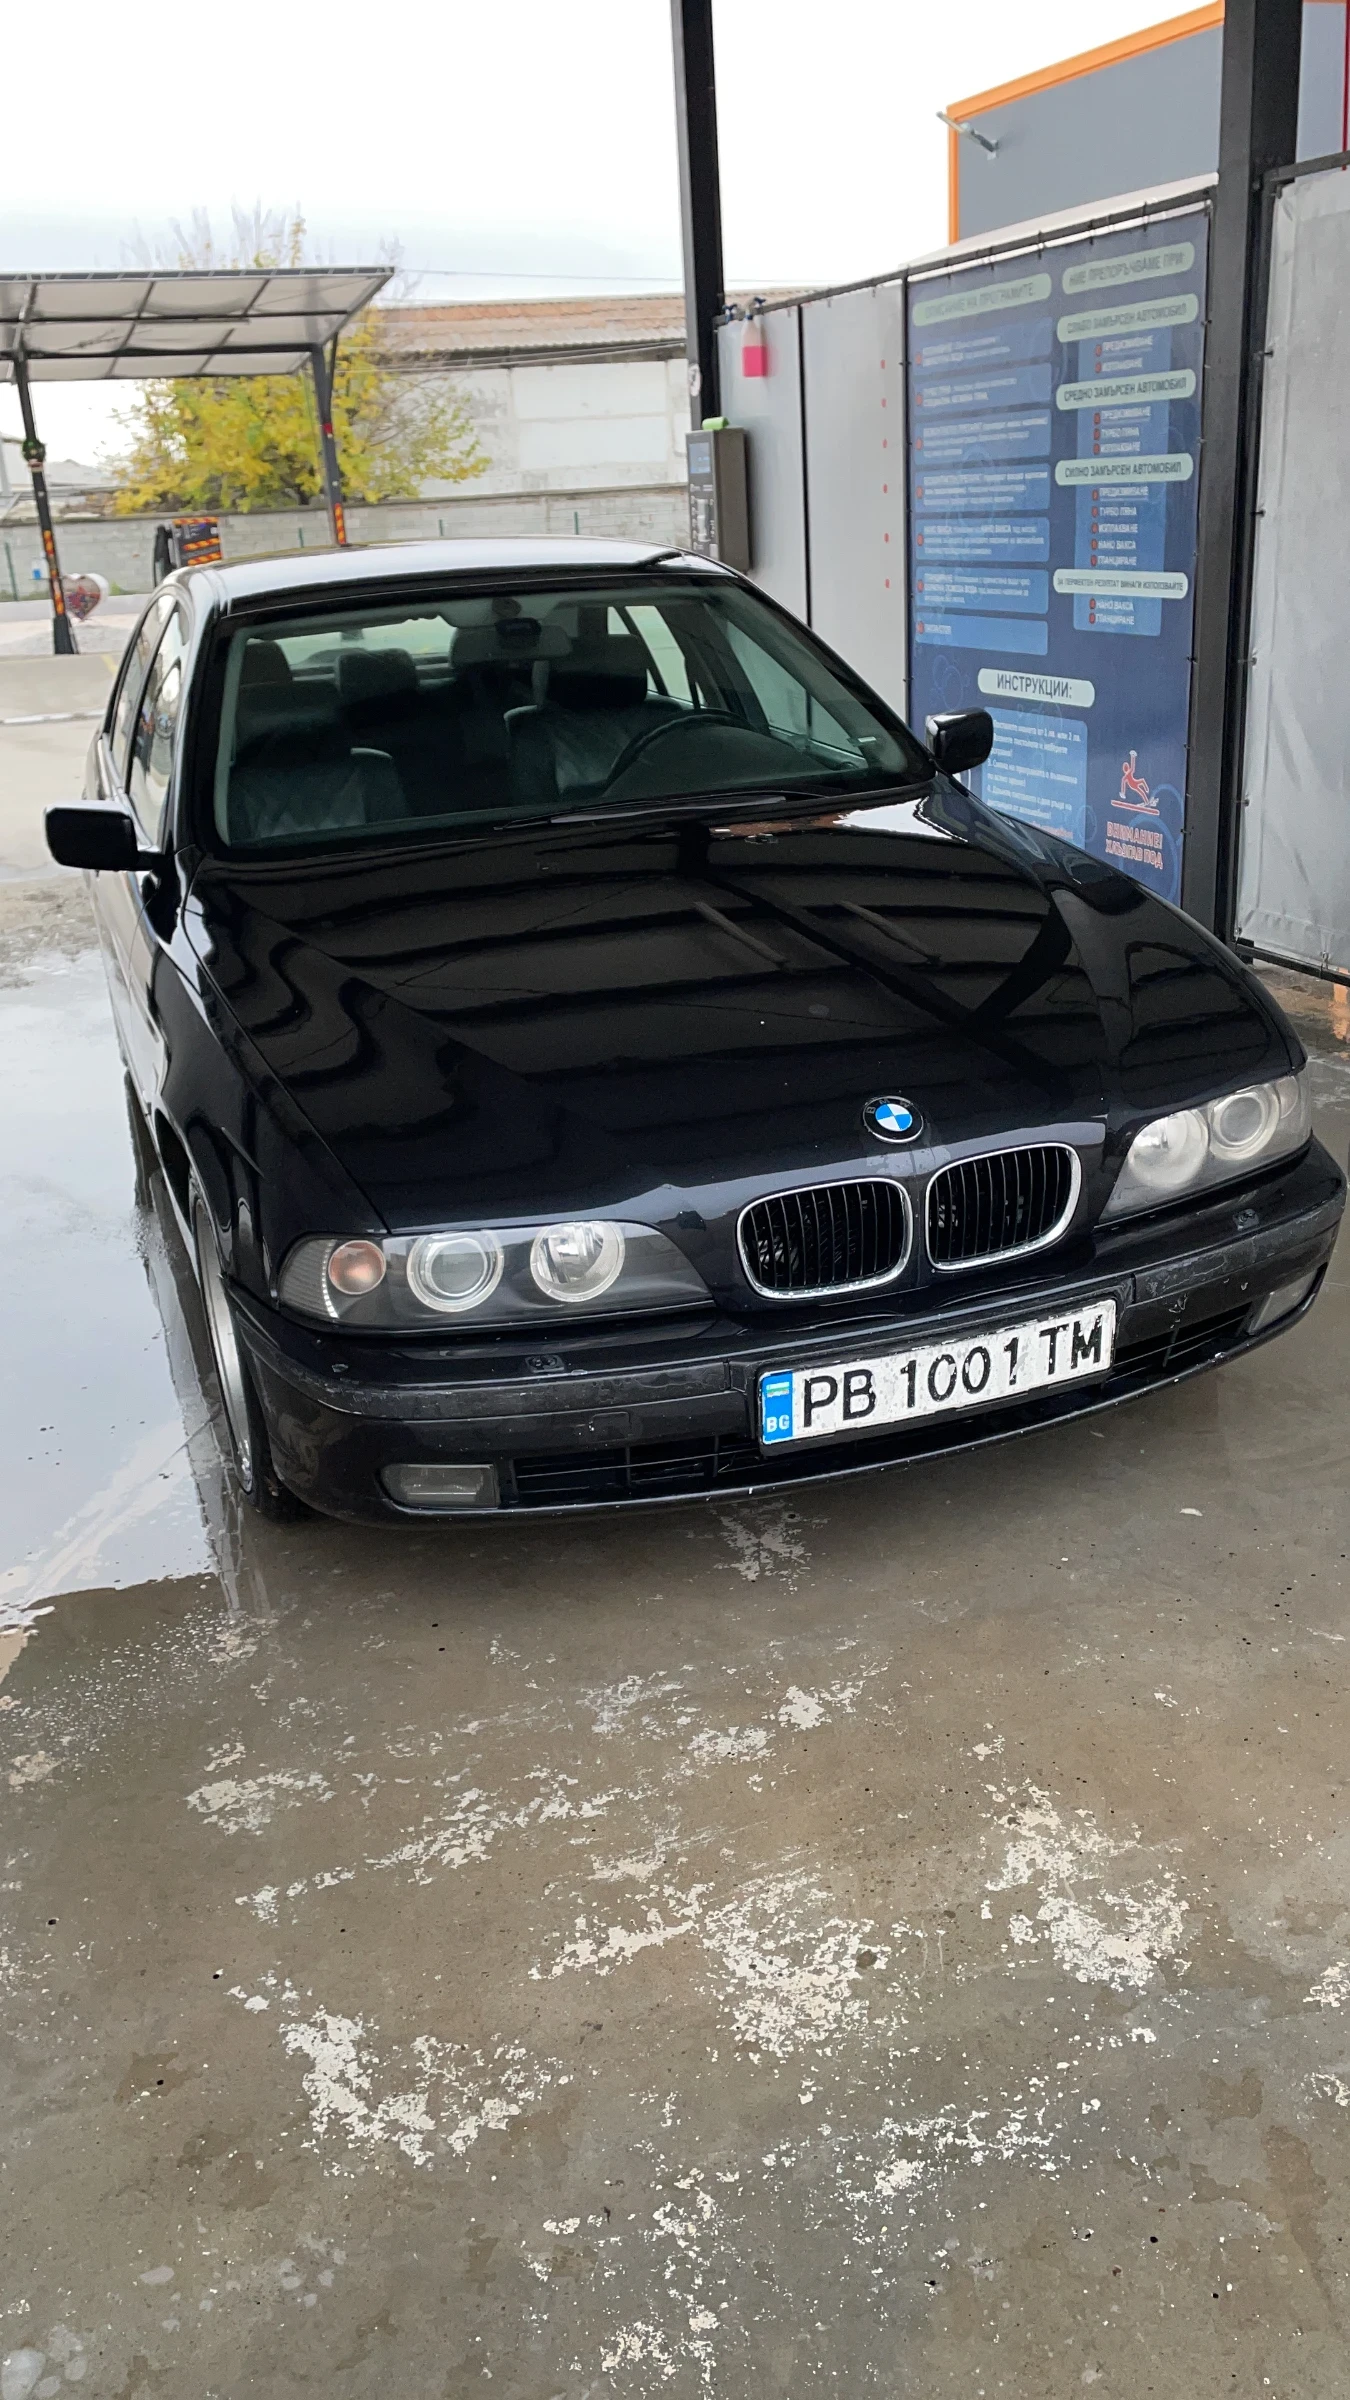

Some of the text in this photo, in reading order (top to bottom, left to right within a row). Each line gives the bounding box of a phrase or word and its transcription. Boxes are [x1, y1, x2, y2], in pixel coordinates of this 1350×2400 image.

[1064, 376, 1187, 402] СРЕДНО ЗАМЪРСЕН АВТОМОБИЛ
[1064, 461, 1182, 478] СИЛНО ЗАМЪРСЕН АВТОМОБИЛ
[997, 673, 1072, 699] ИНСТРУКЦИИ:
[1107, 821, 1163, 850] ВНИМАНИЕ!
[1143, 848, 1163, 870] ПОД
[866, 1098, 911, 1115] BMW
[802, 1315, 1103, 1428] PB 1001 TM
[766, 1416, 790, 1433] BG
